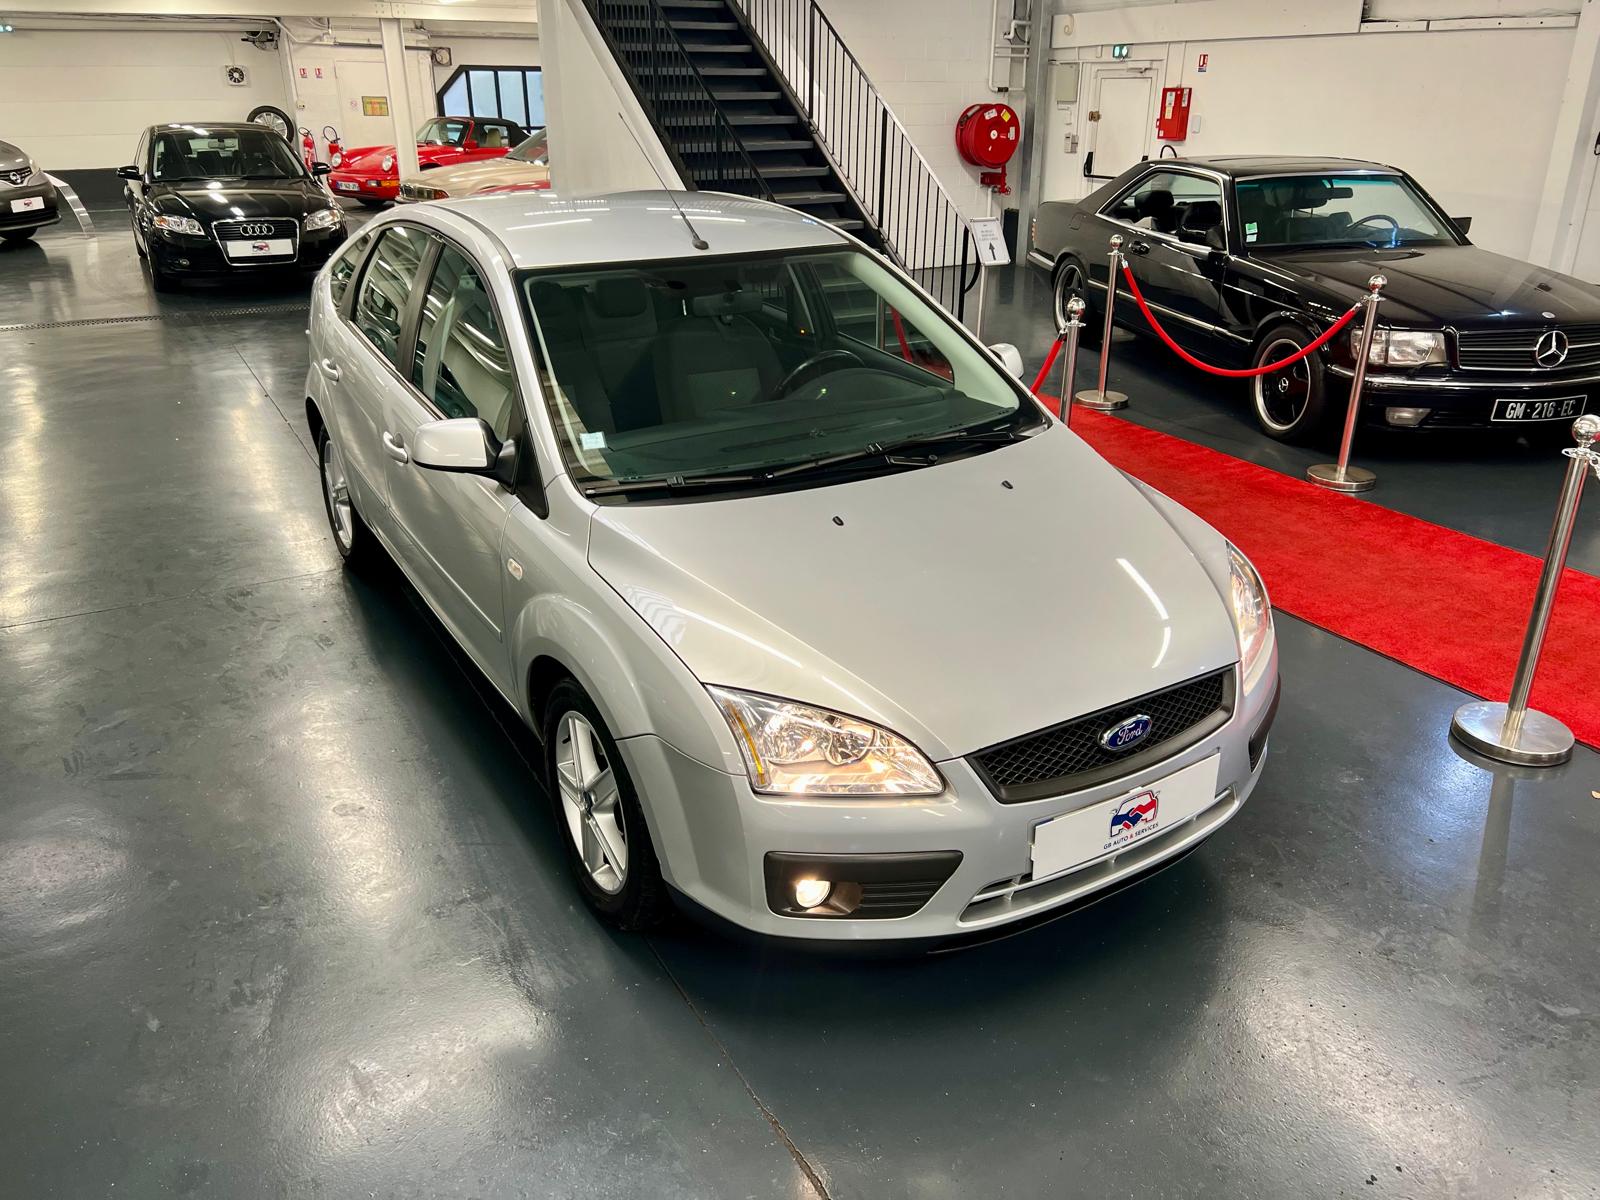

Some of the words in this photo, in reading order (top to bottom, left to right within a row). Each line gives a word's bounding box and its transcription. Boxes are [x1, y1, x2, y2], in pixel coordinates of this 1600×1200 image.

[1117, 723, 1142, 745] Ford
[1113, 836, 1129, 846] AUTO
[1134, 823, 1159, 837] SERVICES
